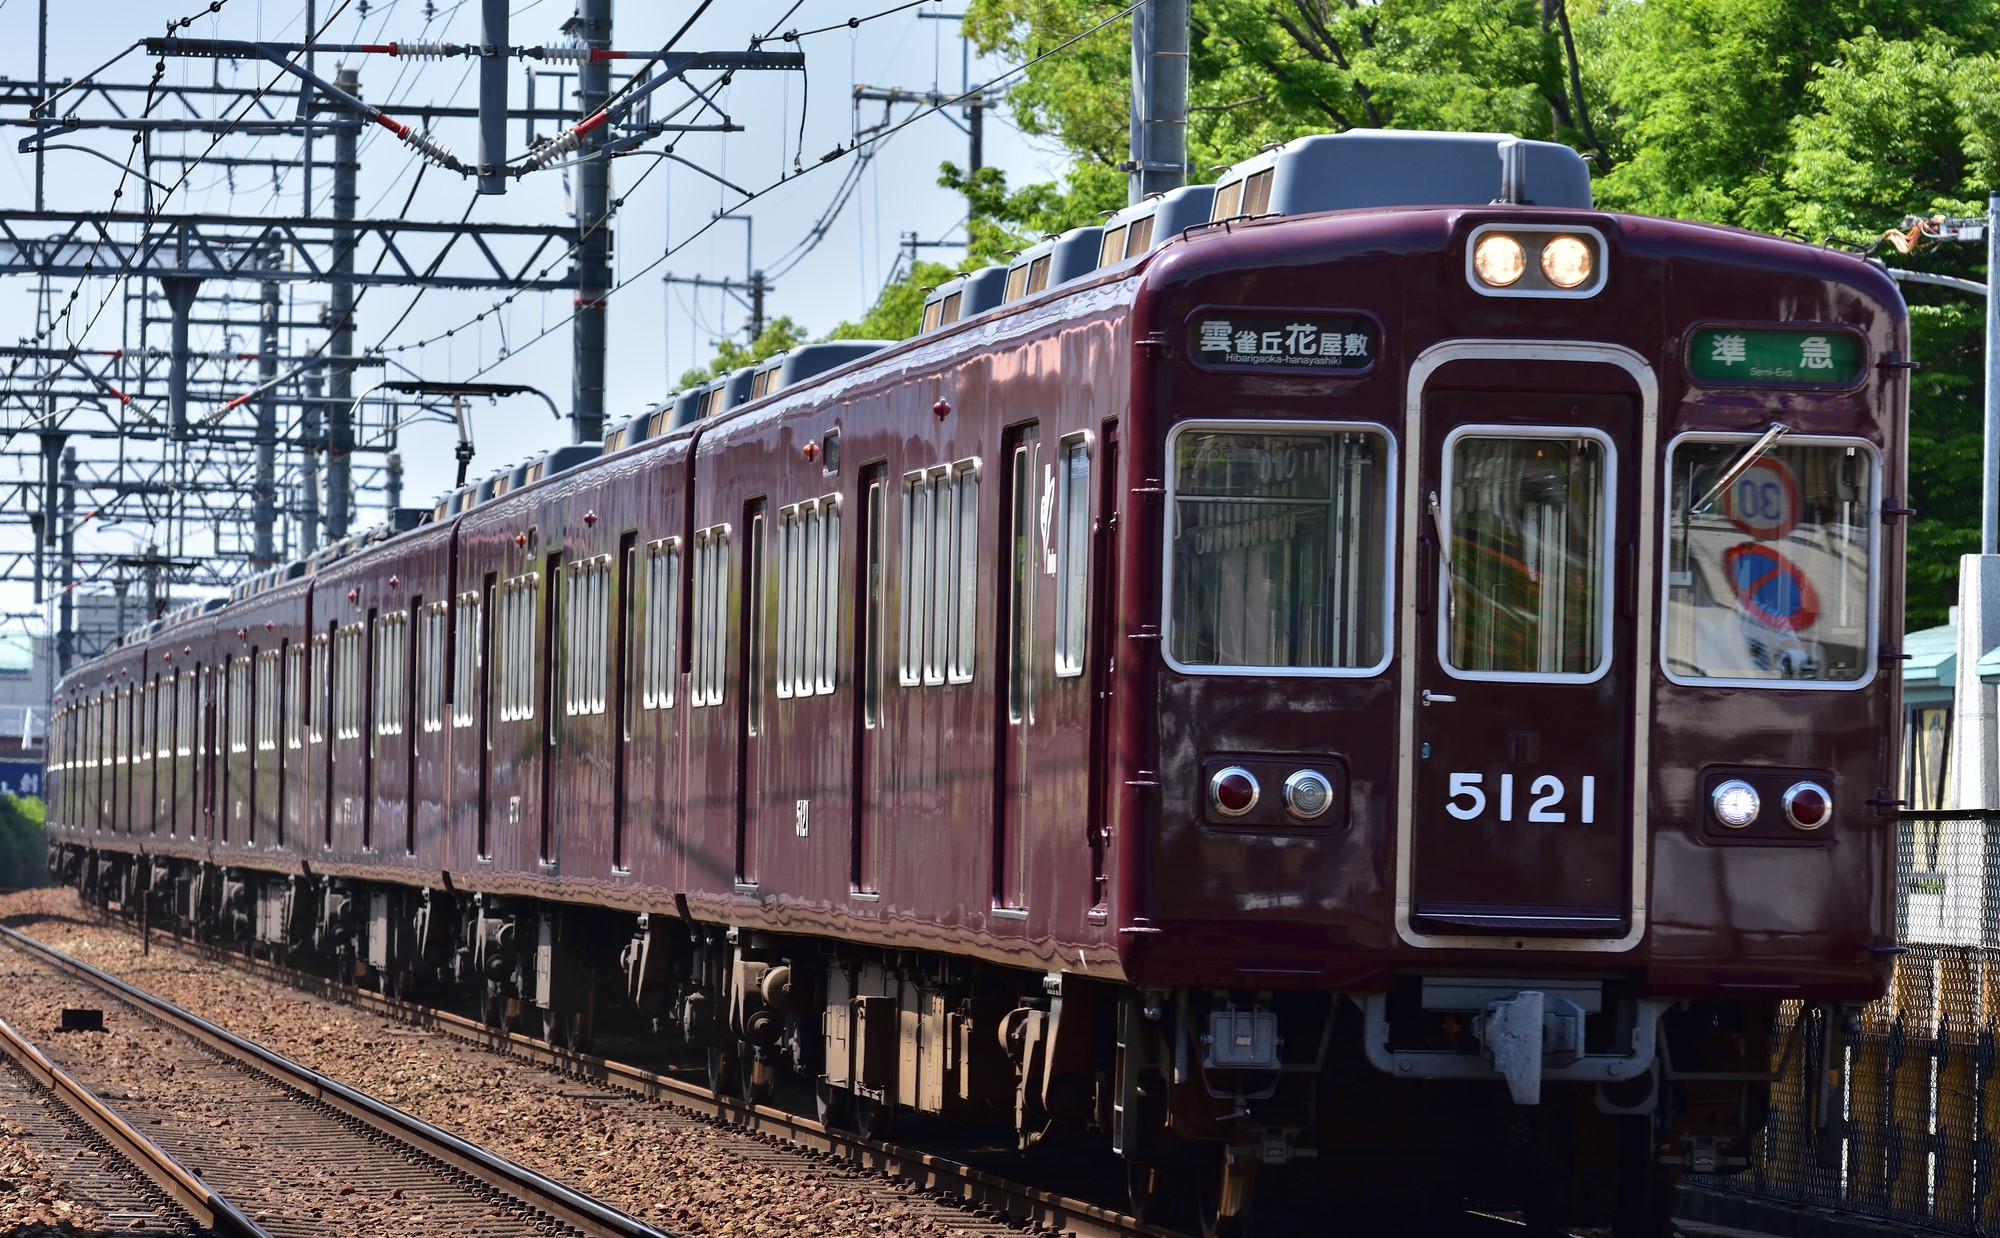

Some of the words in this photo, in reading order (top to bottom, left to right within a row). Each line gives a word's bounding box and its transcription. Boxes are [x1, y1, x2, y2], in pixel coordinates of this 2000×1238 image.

[1200, 320, 1368, 357] 雲雀丘花屋敷
[1225, 354, 1342, 366] Hibarigaoka-hanayashiki
[1446, 773, 1594, 823] 5121
